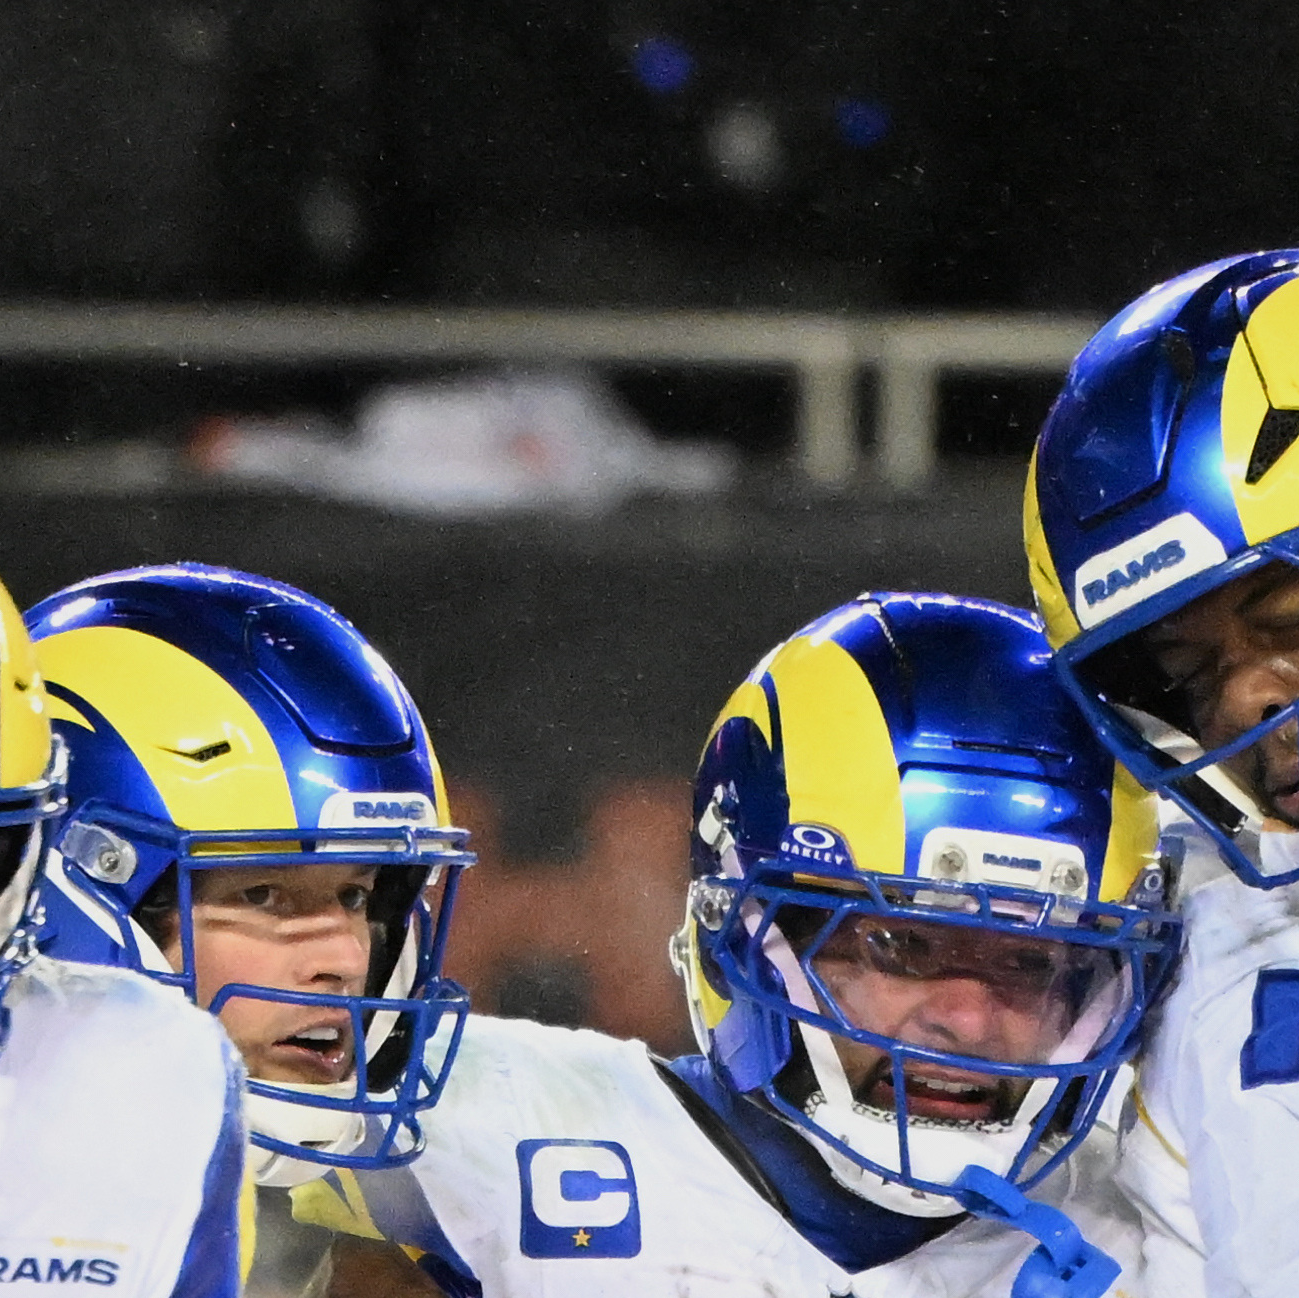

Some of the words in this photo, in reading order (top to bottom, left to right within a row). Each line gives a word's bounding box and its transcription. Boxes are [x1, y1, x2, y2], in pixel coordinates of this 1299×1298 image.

[1081, 539, 1187, 610] RAMS
[353, 801, 426, 821] RAMS
[781, 842, 846, 866] OAKLEY
[530, 1145, 633, 1229] C
